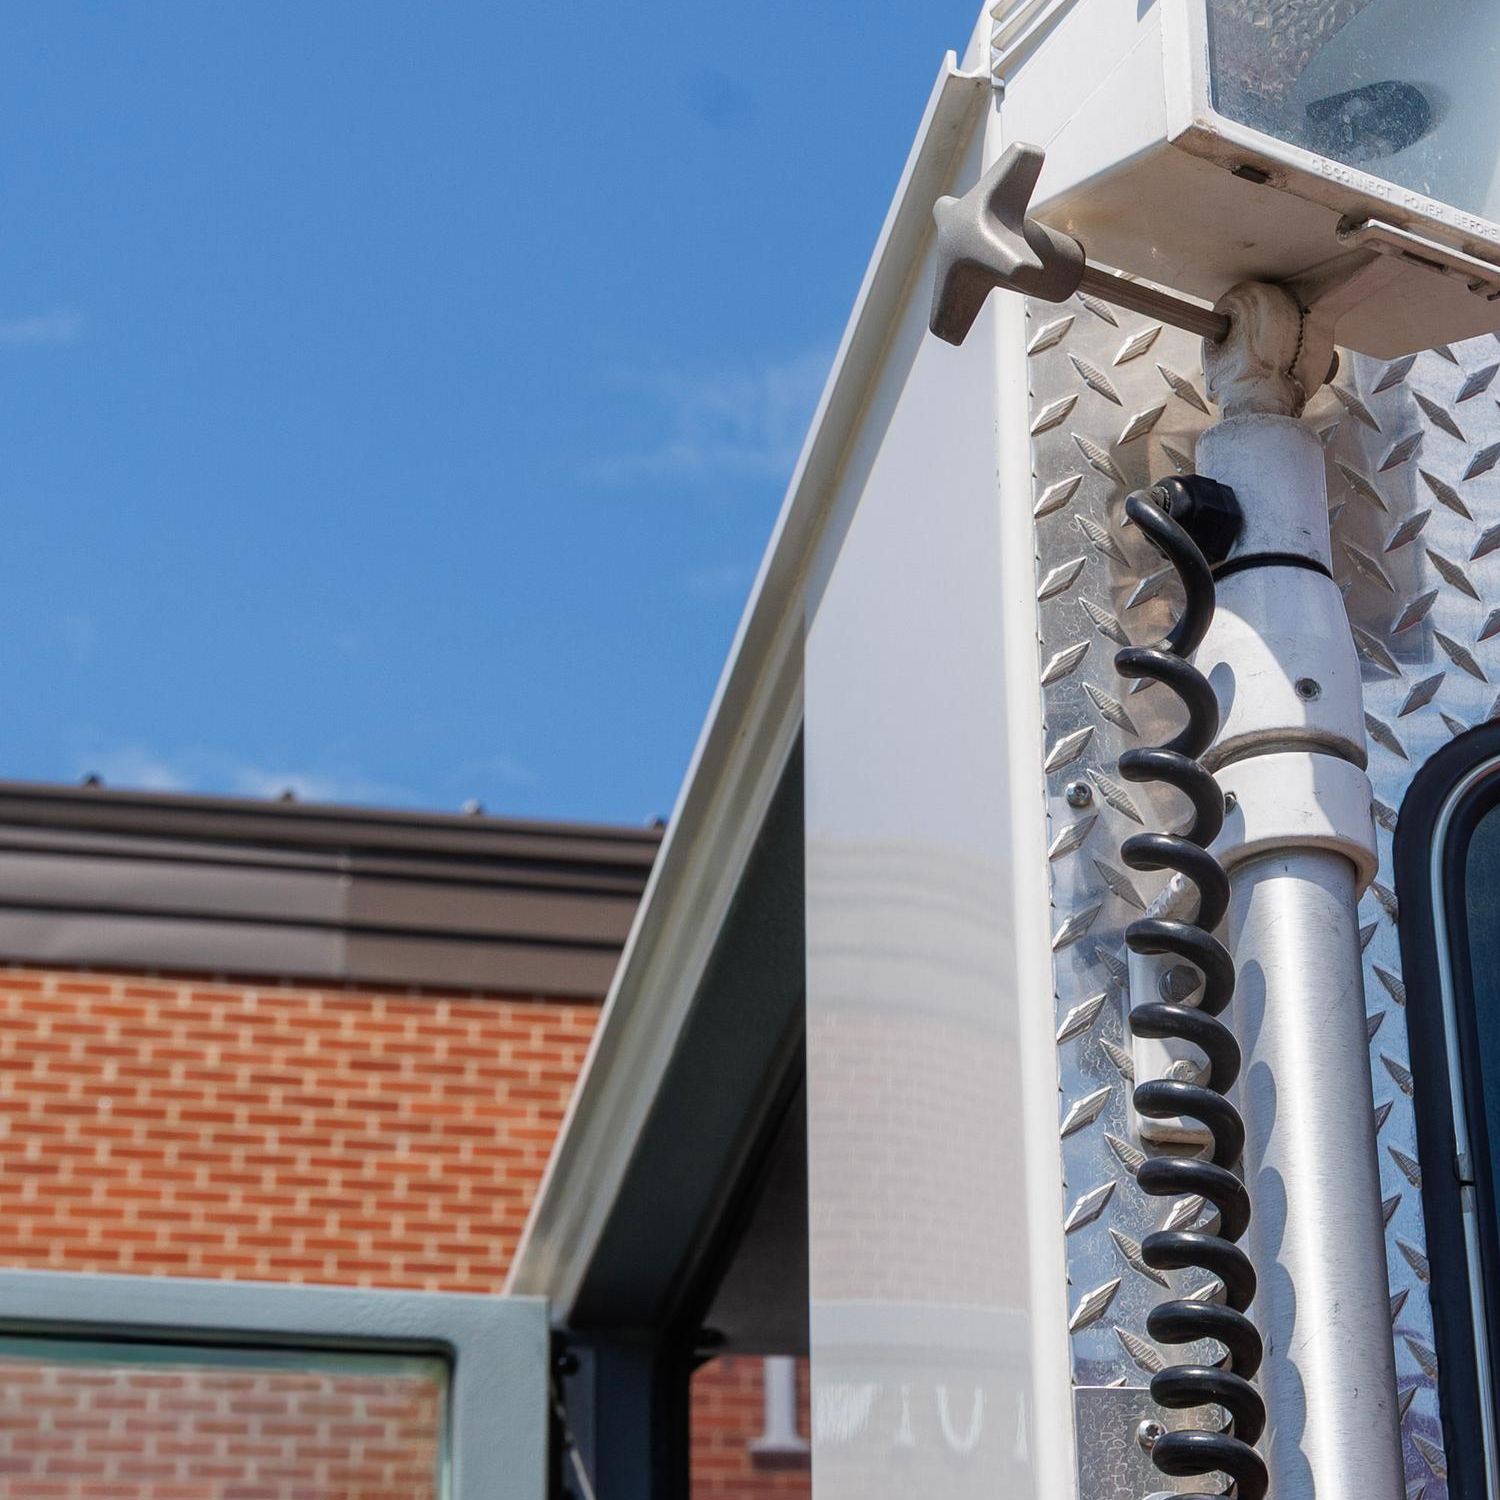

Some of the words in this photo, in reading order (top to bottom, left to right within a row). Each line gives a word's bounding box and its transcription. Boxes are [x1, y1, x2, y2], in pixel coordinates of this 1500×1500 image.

[1311, 157, 1392, 195] DISCONNECT
[1403, 192, 1445, 219] POWER
[1454, 213, 1498, 237] BEFORE
